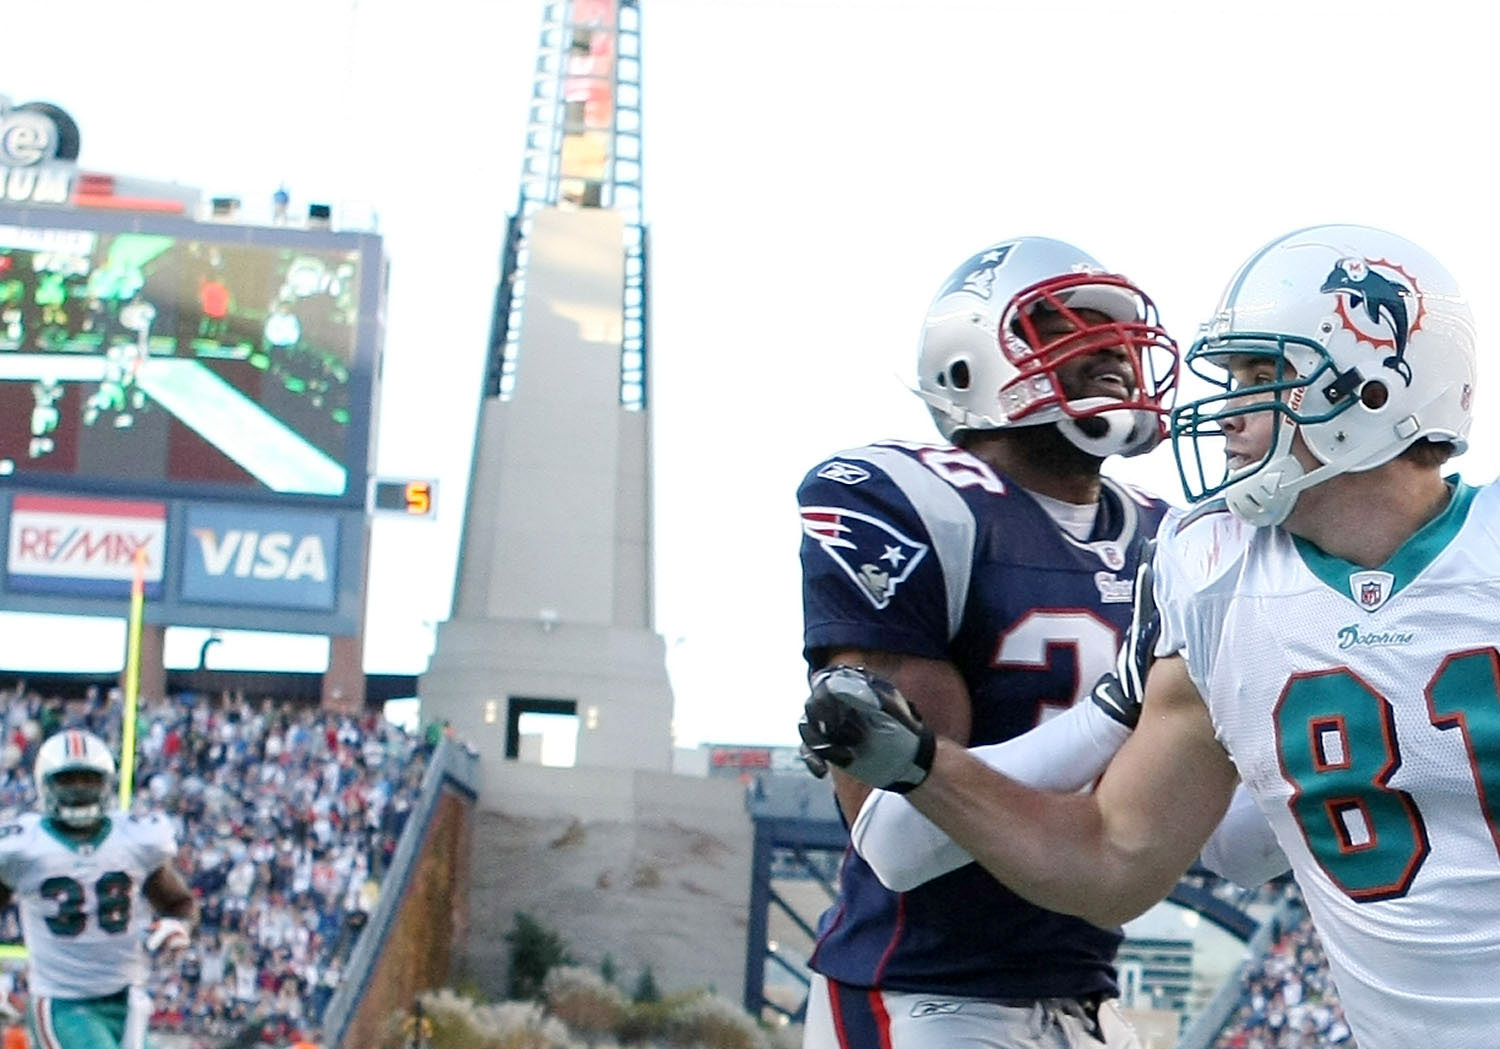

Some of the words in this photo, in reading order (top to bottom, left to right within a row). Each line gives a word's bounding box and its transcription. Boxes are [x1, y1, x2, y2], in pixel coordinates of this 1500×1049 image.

[18, 524, 156, 567] RE/MAX
[193, 527, 328, 582] VISA
[1337, 623, 1414, 650] Dolphins
[40, 870, 133, 936] 38
